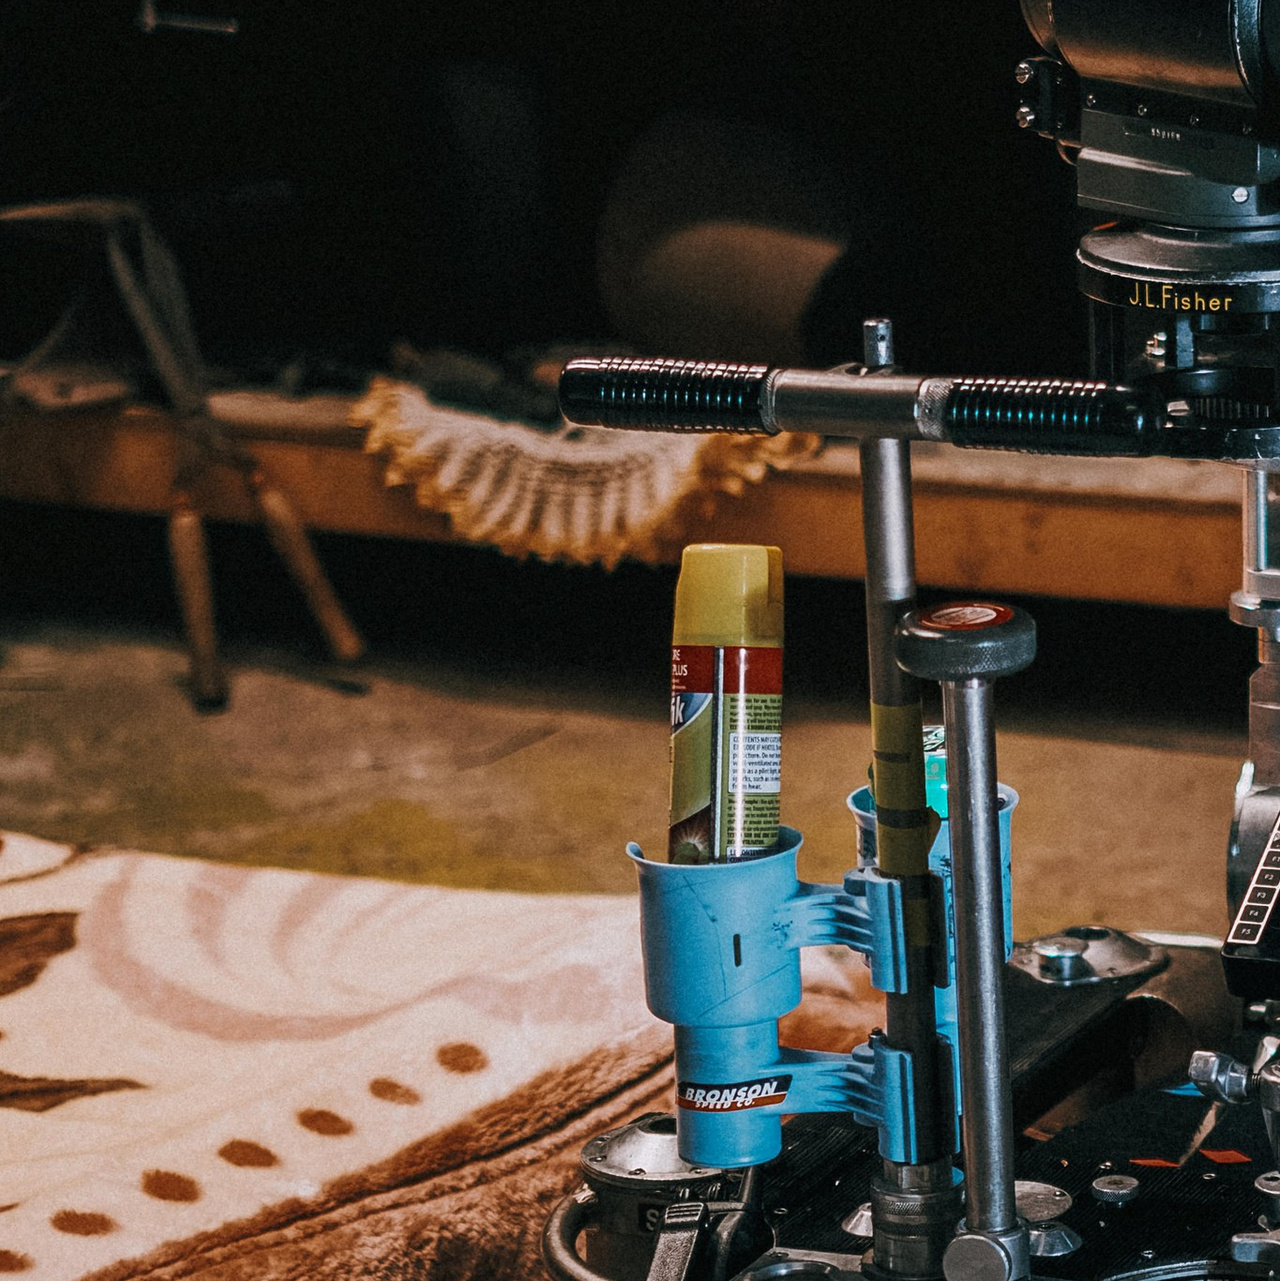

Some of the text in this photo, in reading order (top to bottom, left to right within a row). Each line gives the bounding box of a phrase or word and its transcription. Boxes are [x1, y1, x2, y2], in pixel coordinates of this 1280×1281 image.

[1129, 281, 1233, 311] J.L.Fisher
[685, 1081, 778, 1102] BRONSON
[695, 1100, 732, 1109] SPEED
